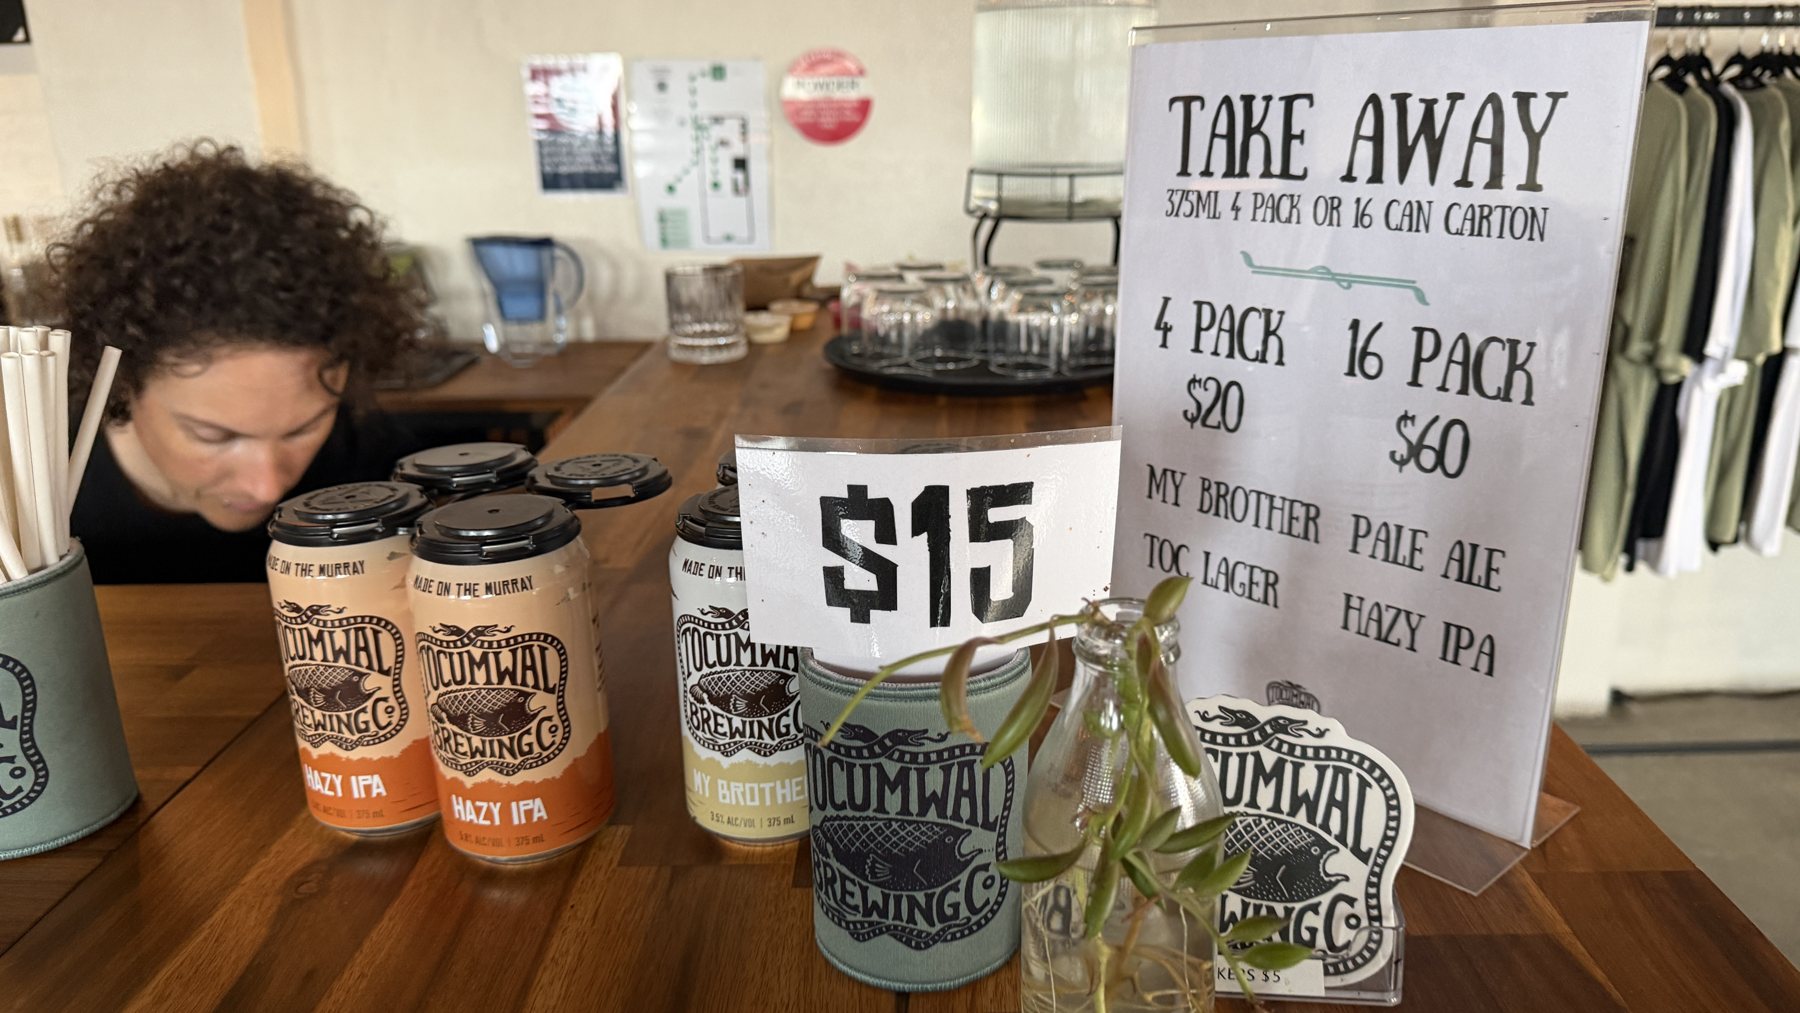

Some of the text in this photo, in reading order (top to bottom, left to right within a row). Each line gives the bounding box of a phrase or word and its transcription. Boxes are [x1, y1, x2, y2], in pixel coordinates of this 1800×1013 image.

[1168, 91, 1569, 192] TAKE AWAY
[1165, 188, 1549, 242] 375ML 4 PACK OR 16 CAN CARTON
[1153, 296, 1286, 366] 4 PACK
[1343, 318, 1537, 406] 16 PACK
[1182, 374, 1245, 433] $20
[1389, 410, 1471, 479] $60
[1146, 464, 1321, 544] MY BROTHER
[280, 560, 292, 575] ON
[295, 562, 314, 578] THE
[319, 560, 366, 577] MURRAY
[681, 558, 746, 581] MADE ON TH
[819, 481, 1035, 628] $15
[1143, 532, 1280, 609] TOC LAGER
[1348, 513, 1506, 593] PALE ALE
[437, 581, 450, 596] ON
[456, 582, 480, 598] THE
[485, 575, 534, 597] MURRAY
[681, 626, 799, 678] TOCUMWA
[1340, 592, 1497, 678] HAZY IPA
[419, 644, 558, 700] TOCUMWAL
[303, 763, 387, 799] HAZY IPA
[692, 768, 808, 806] MY BROTHE
[451, 794, 548, 826] HAZY IPA
[727, 815, 755, 828] ALC/VOL
[767, 816, 782, 828] 375
